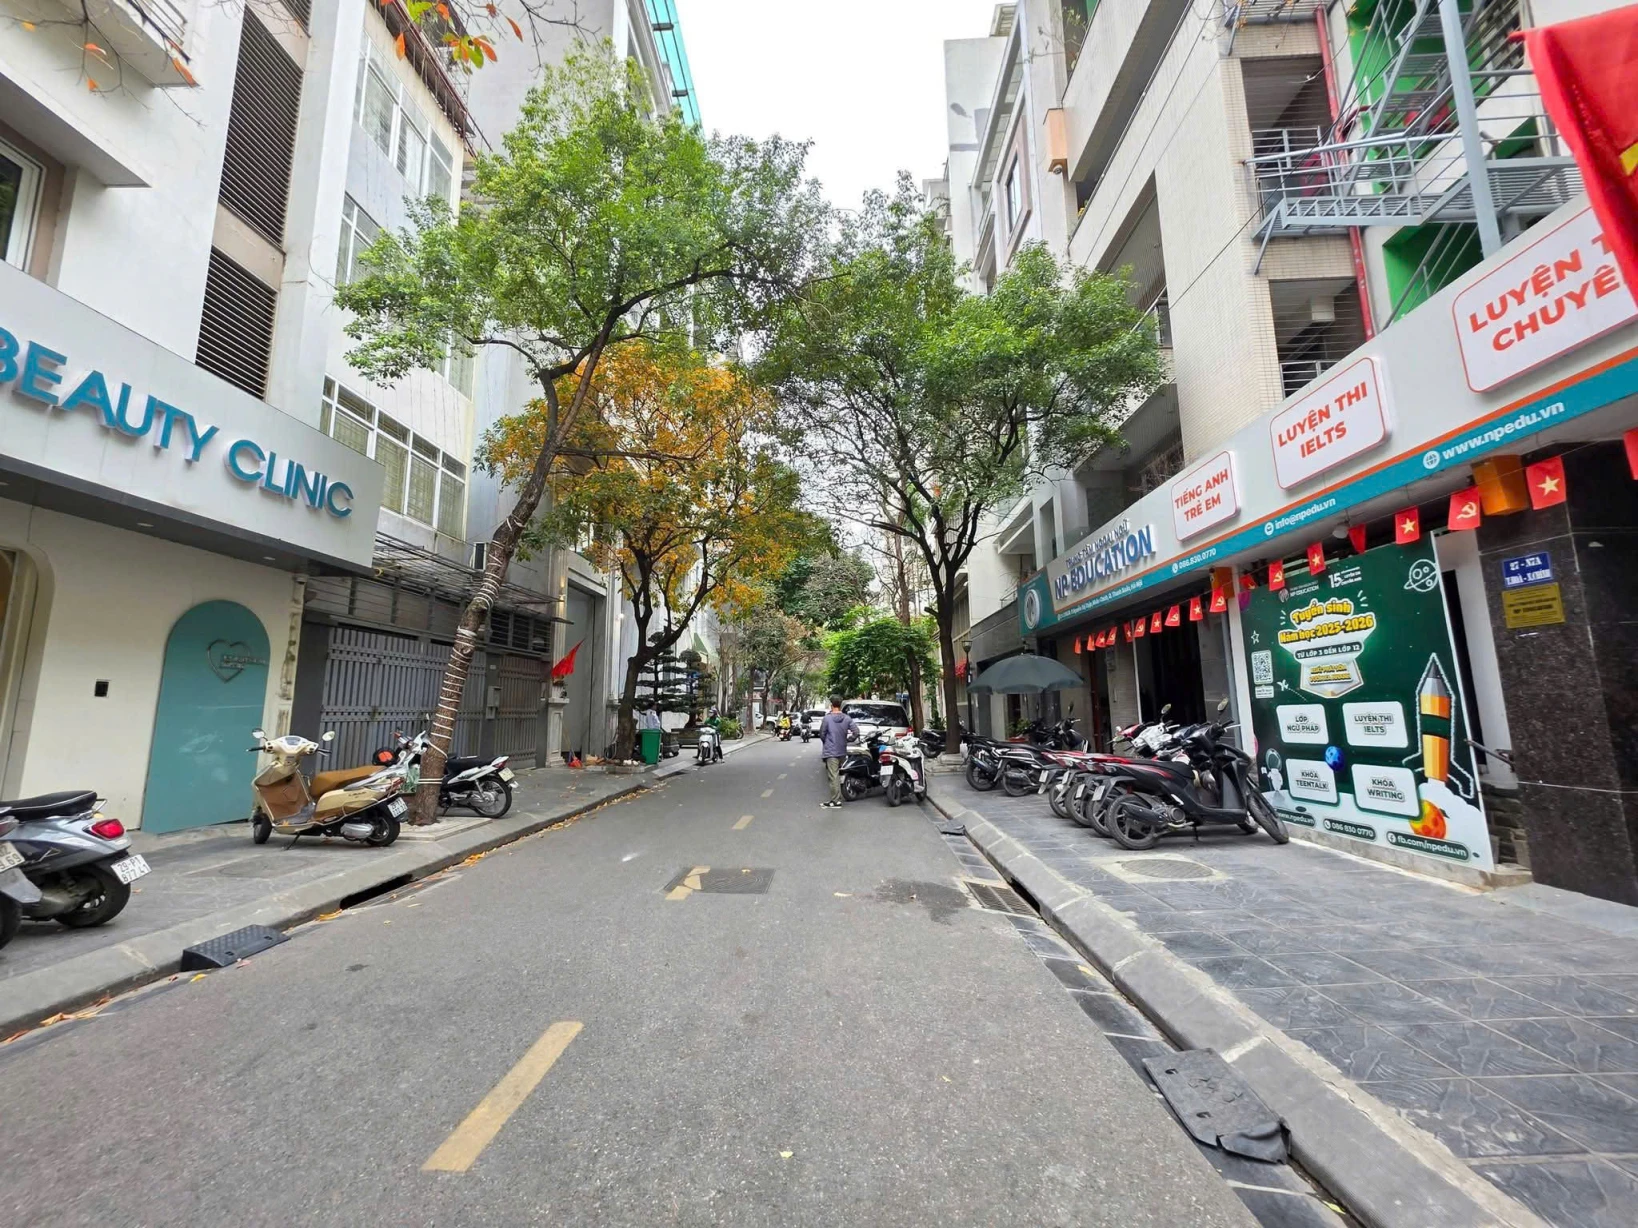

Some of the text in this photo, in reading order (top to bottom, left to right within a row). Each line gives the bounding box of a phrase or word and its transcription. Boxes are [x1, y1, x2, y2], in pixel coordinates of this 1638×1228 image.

[1469, 249, 1582, 333] LUYỆN
[1492, 264, 1620, 351] CHUYÊ
[1278, 381, 1368, 447] LUYỆN THI
[1300, 421, 1347, 458] IELTS
[1442, 401, 1565, 459] www.npedu.vn
[226, 439, 354, 518] CLINIC
[1175, 468, 1229, 509] TIẾNG ANH
[1184, 492, 1222, 522] TRẺ EM
[1275, 498, 1336, 530] info@npedu.vn
[1055, 524, 1153, 600] NP EDUCATION
[1292, 600, 1351, 624] Tuyển sinh
[1299, 628, 1316, 643] học
[1316, 615, 1374, 638] 2025-2026
[1306, 649, 1317, 657] LỚP
[1338, 644, 1351, 653] LỚP
[1354, 713, 1392, 724] LUYỆN THI
[1363, 725, 1385, 734] IELTS
[1295, 779, 1328, 790] TEENTALK
[1367, 788, 1404, 801] WRITING
[1331, 821, 1374, 838] 086 830 0770
[1397, 834, 1467, 857] fb.com/npedu.vn
